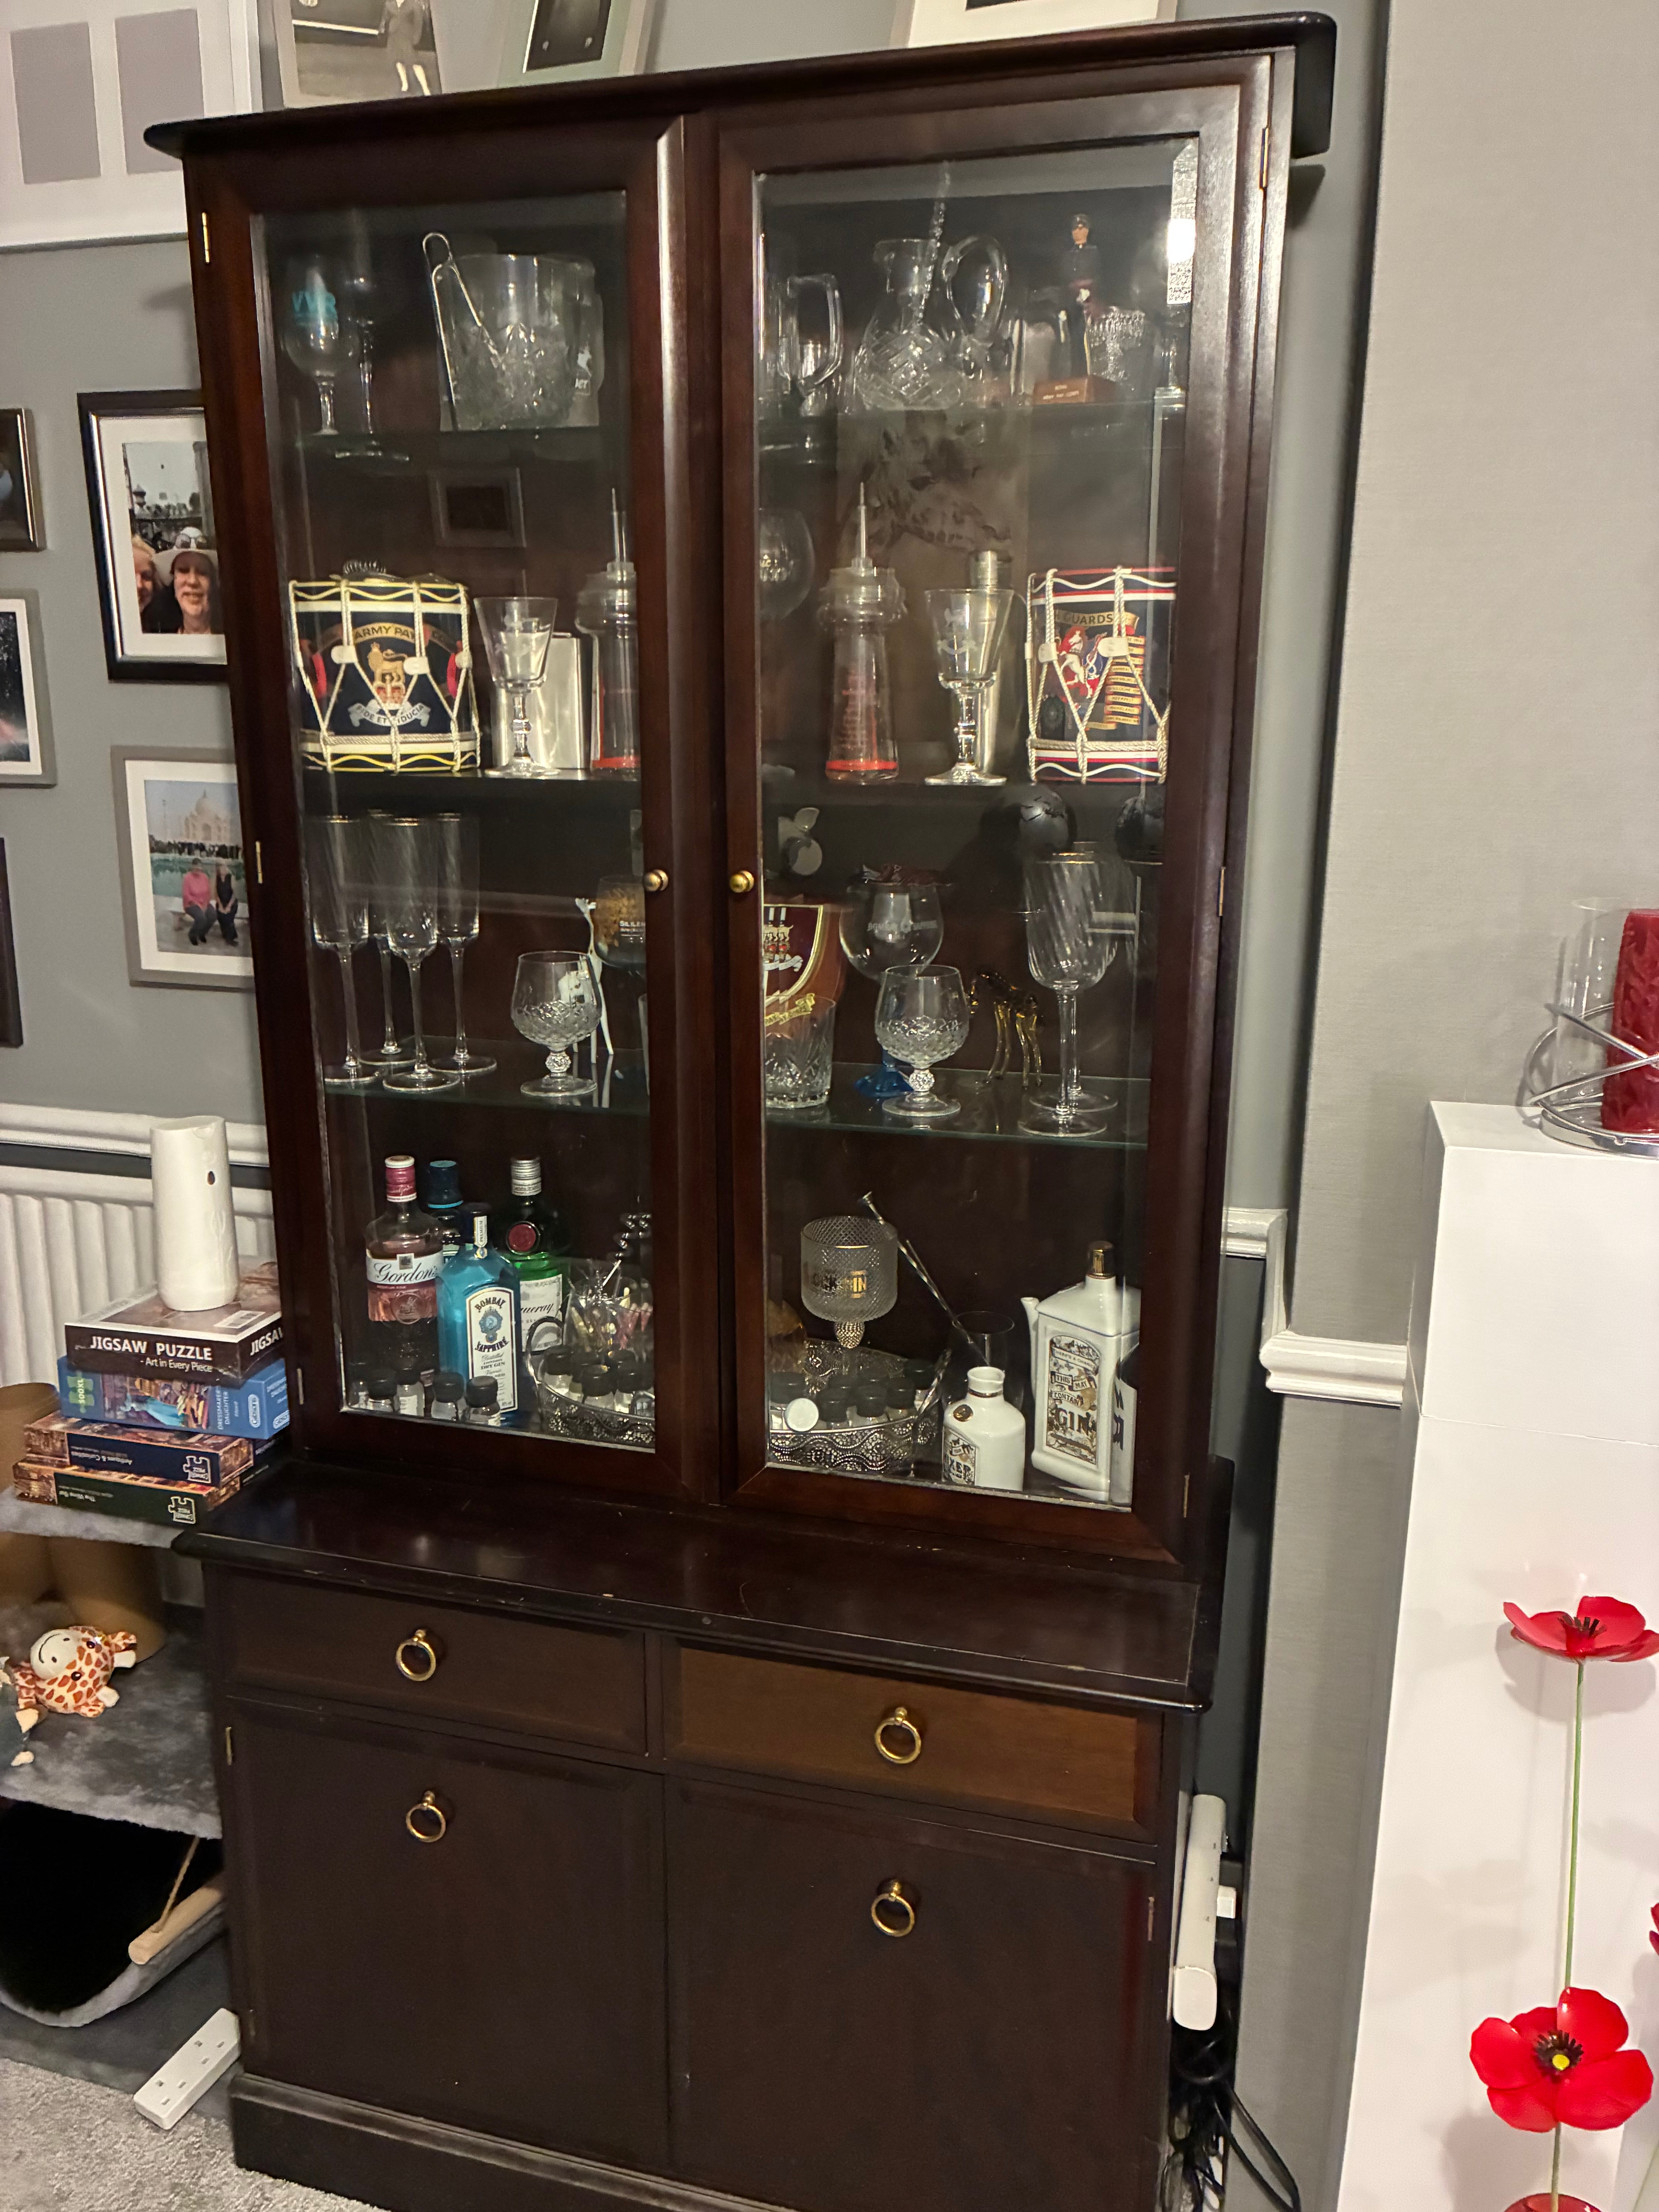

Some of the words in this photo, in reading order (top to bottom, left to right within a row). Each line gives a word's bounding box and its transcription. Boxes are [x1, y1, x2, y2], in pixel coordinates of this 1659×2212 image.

[355, 626, 391, 639] ARMY
[397, 704, 424, 723] IDUCIA
[474, 1297, 506, 1313] BOMBAY
[520, 1303, 554, 1314] ueray
[90, 1336, 147, 1354] JIGSAW
[156, 1342, 213, 1361] PUZZLE
[474, 1336, 510, 1353] SAPPHIRE
[146, 1357, 158, 1366] Art
[159, 1358, 167, 1367] in
[168, 1360, 190, 1372] Every
[191, 1362, 213, 1373] Piece
[1056, 1374, 1070, 1384] THIS
[1074, 1381, 1087, 1389] MAY
[1054, 1408, 1091, 1436] GIN
